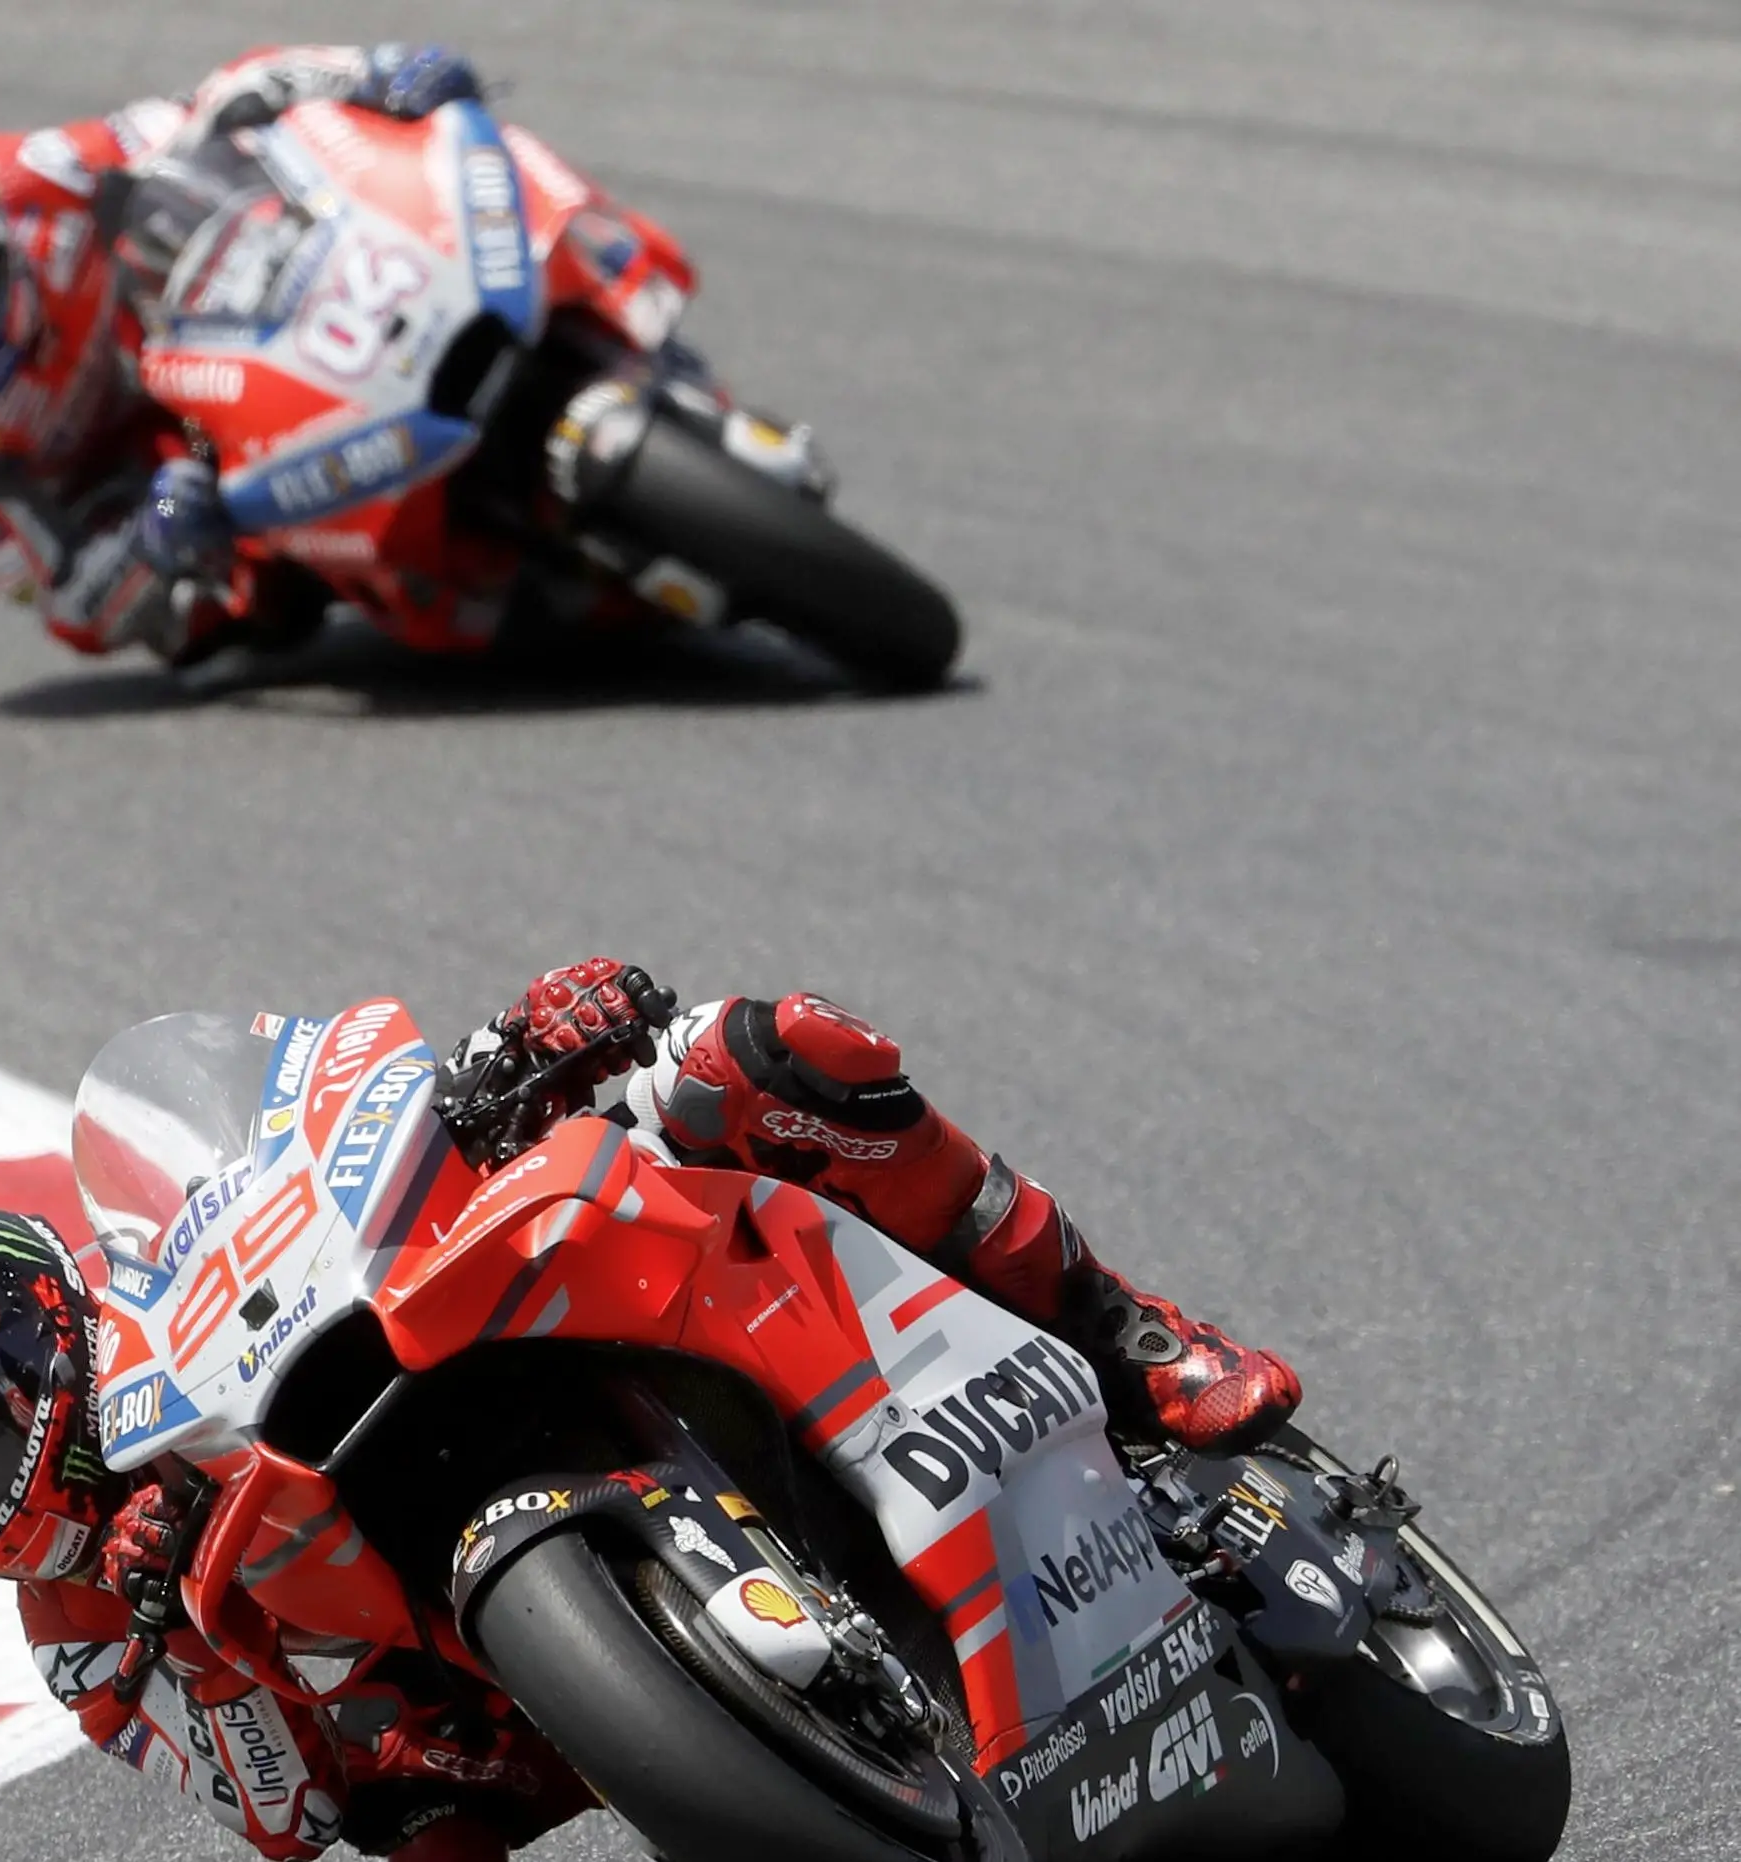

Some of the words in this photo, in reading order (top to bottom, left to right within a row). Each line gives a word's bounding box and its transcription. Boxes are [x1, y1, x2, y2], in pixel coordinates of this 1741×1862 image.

[278, 1018, 324, 1096] ADVANCE
[329, 1056, 435, 1189] FLEX-BOX
[164, 1164, 253, 1277] valsir
[429, 1154, 548, 1244] Lenovo
[167, 1166, 320, 1375] 99
[237, 1285, 320, 1383] Unibat
[98, 1375, 166, 1453] EX-BOX
[881, 1335, 1098, 1512] DUCATI
[56, 1528, 87, 1572] DUCATI
[1029, 1507, 1154, 1629] NetApp
[1099, 1653, 1163, 1735] valsir
[1162, 1606, 1217, 1689] SKF
[1020, 1718, 1088, 1792] PittaRosso
[1148, 1691, 1224, 1802] GIVI
[1070, 1757, 1140, 1842] Unibat
